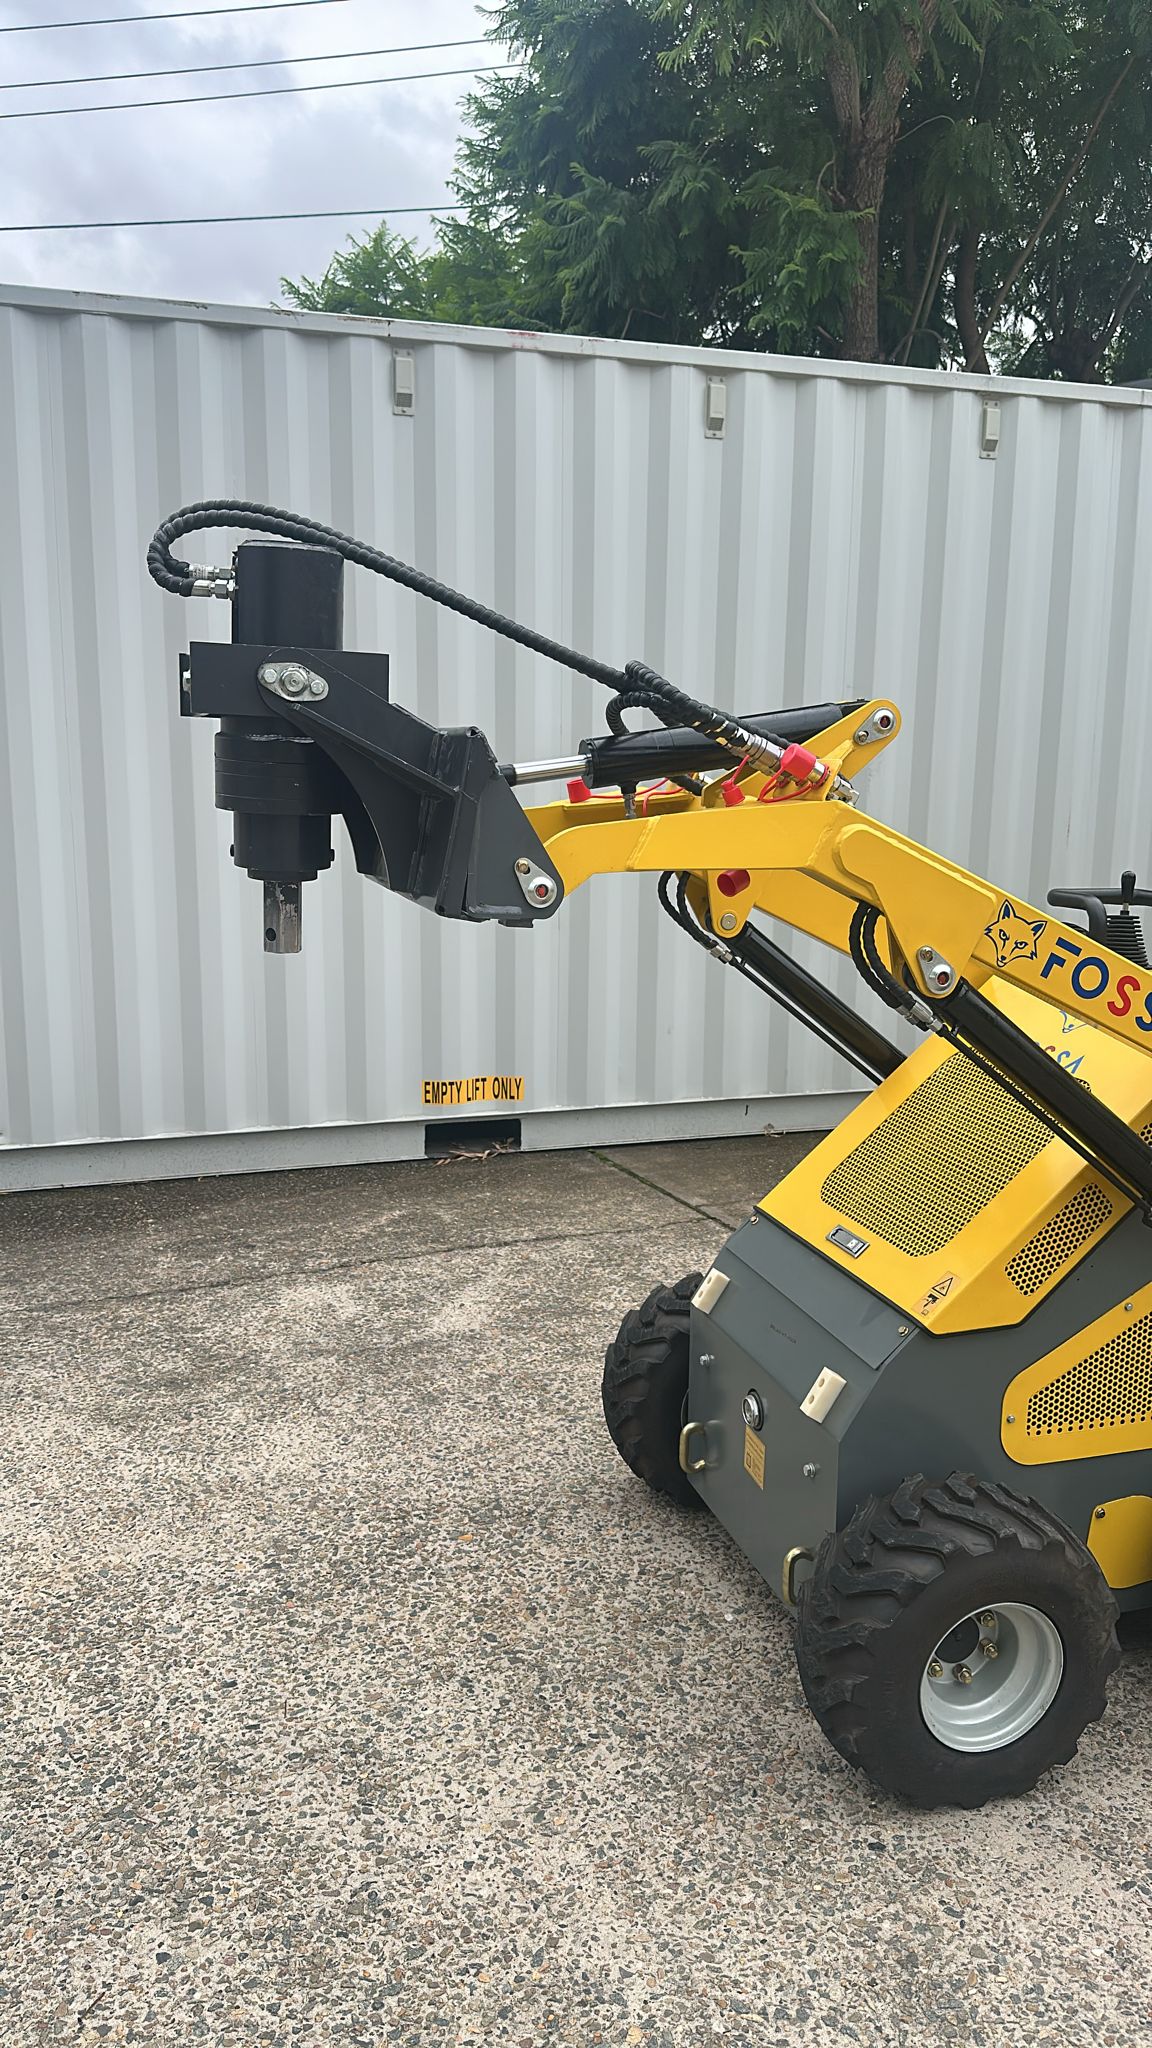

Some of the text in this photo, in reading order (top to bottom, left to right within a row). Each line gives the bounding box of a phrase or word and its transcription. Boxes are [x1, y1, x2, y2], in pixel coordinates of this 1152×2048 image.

[424, 1076, 522, 1104] EMPTY LIFT ONLY
